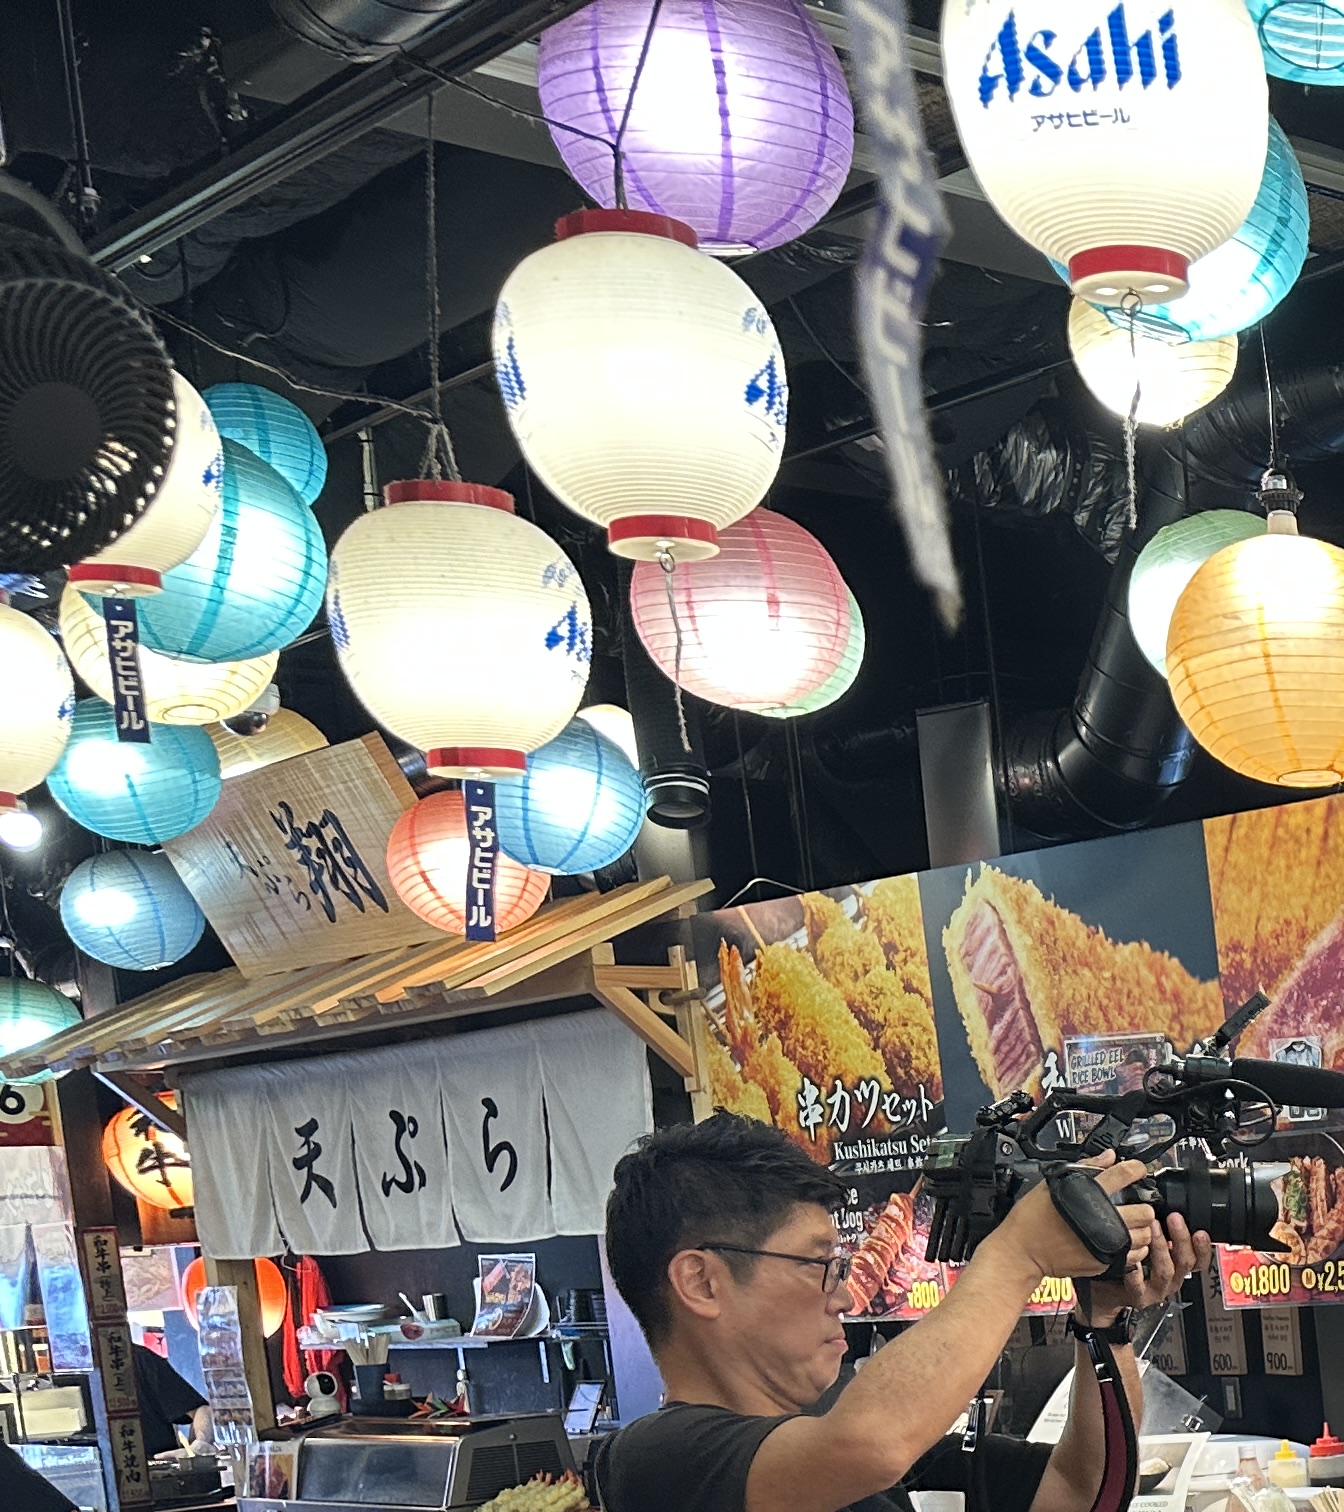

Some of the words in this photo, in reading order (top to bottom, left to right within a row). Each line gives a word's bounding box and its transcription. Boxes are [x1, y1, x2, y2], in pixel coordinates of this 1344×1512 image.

[978, 2, 1182, 109] Asahi
[1031, 107, 1130, 132] アサヒビール
[109, 619, 145, 731] アサヒビール
[470, 805, 495, 928] アサヒビール
[797, 1078, 934, 1141] 串カツセット
[834, 1139, 908, 1161] Kushikatsu
[292, 1097, 517, 1208] 天ぷら
[1244, 1264, 1291, 1297] ¥1,800
